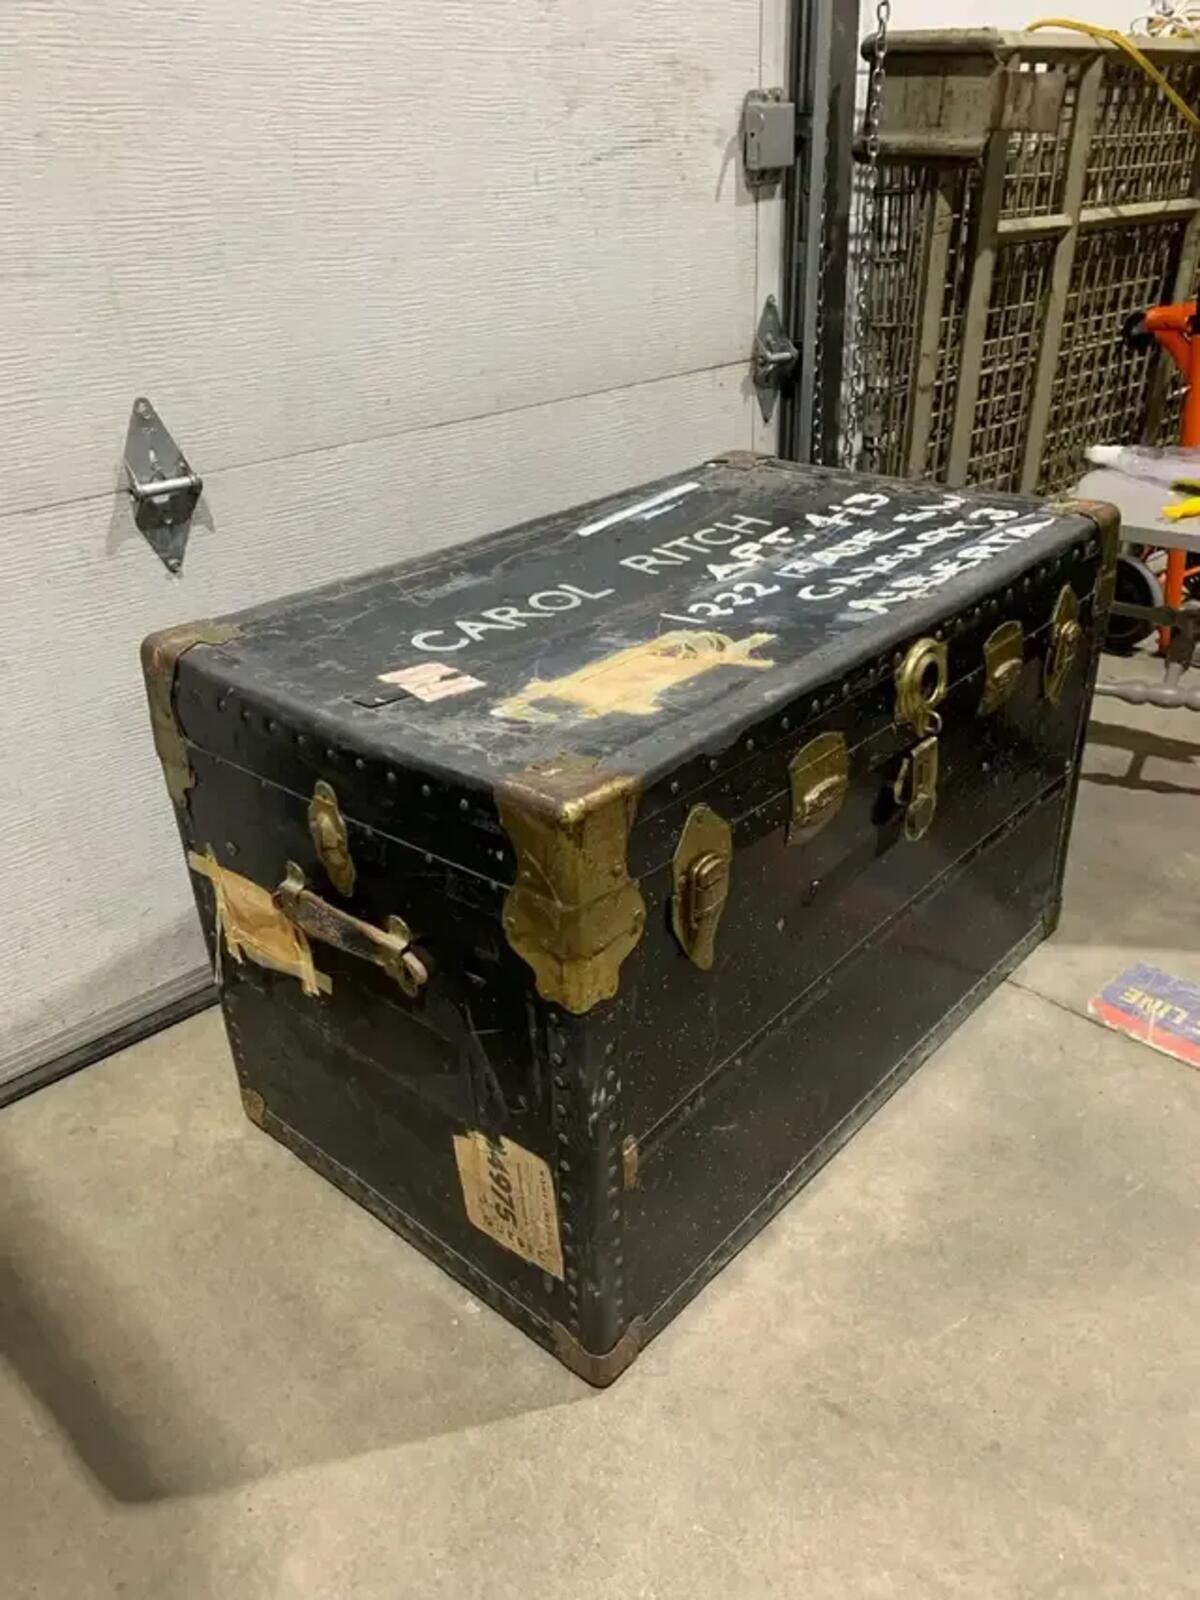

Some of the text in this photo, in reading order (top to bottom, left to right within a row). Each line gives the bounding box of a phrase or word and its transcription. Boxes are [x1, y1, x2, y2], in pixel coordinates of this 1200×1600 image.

[410, 513, 773, 654] CAROL RITCH
[660, 583, 780, 624] 1222
